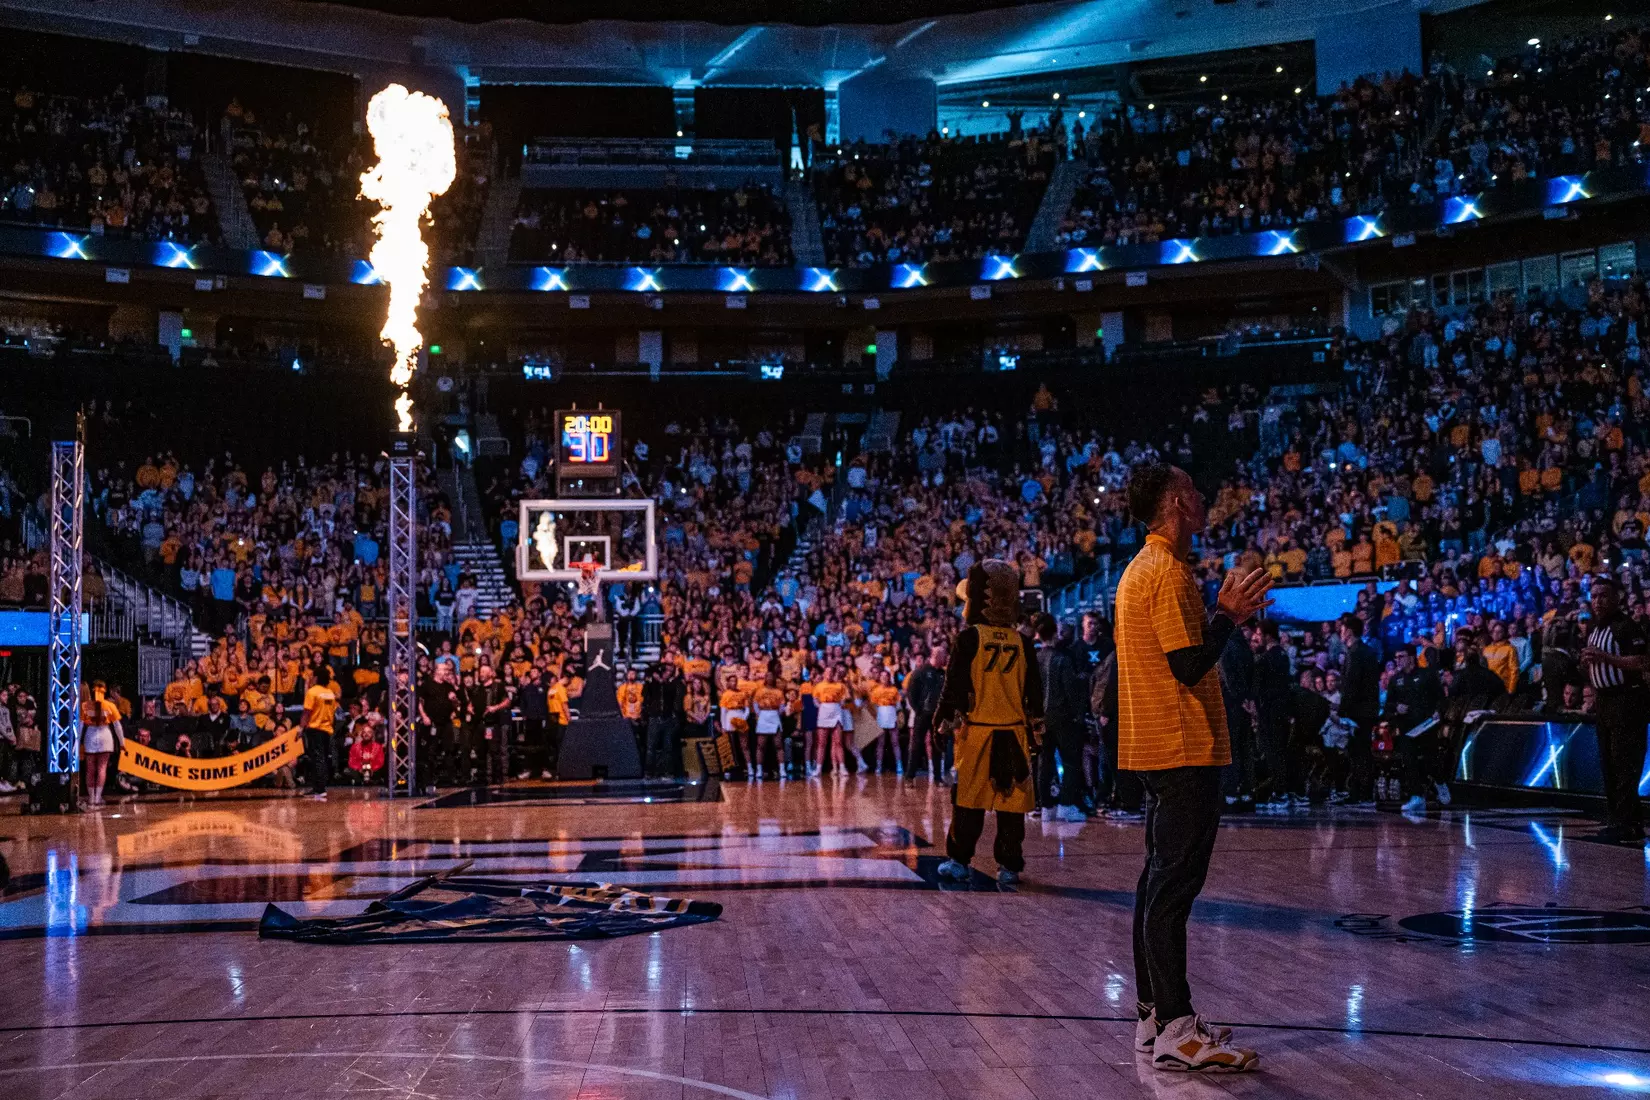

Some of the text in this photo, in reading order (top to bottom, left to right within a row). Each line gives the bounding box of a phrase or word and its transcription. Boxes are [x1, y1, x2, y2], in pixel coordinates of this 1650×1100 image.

[564, 415, 613, 433] 20:00
[568, 433, 609, 462] 30
[983, 642, 1020, 674] 77
[135, 741, 290, 781] MAKE SOME NOISE
